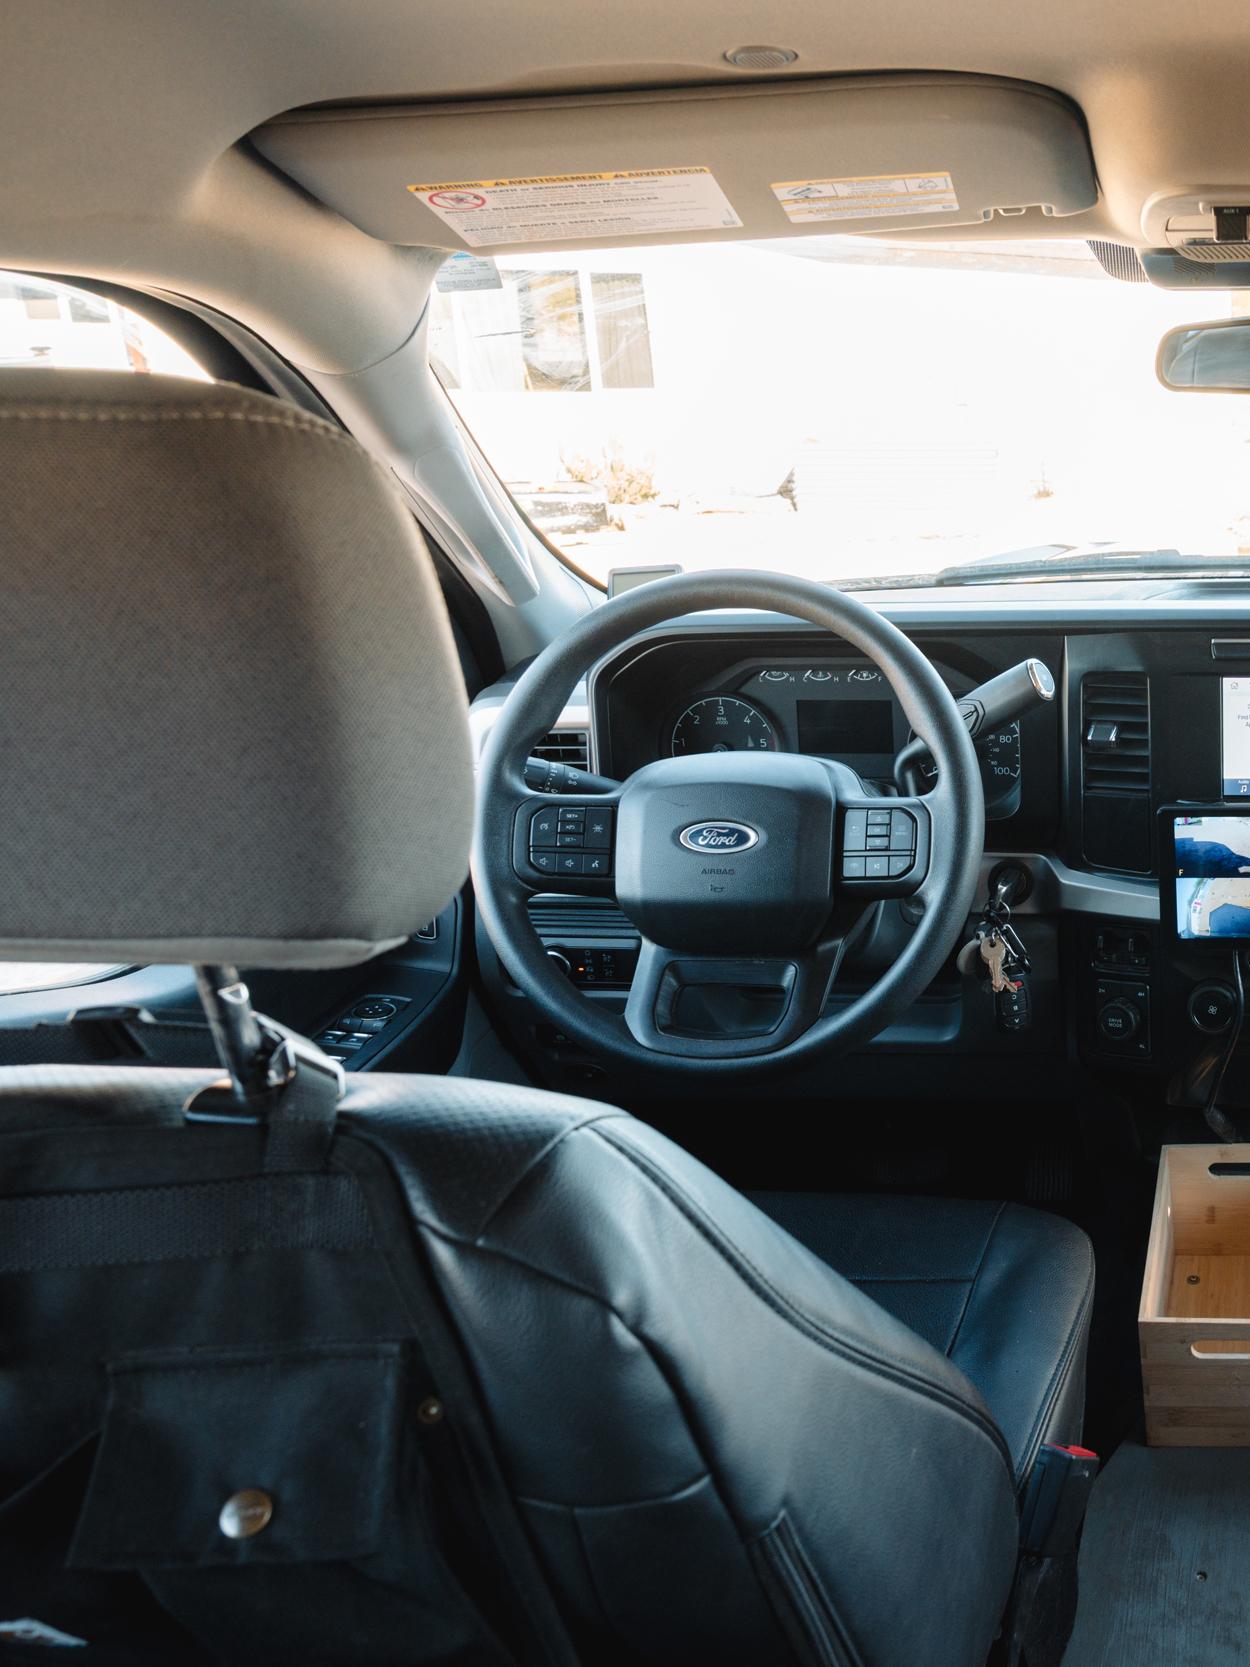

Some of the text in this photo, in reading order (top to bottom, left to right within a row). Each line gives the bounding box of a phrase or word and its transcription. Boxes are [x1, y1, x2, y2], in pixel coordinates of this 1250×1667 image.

[427, 167, 707, 191] WARNING AVERTISSEMENT ADVERTENCIA
[718, 706, 724, 715] 3
[694, 716, 700, 724] 2
[744, 716, 751, 724] 4
[999, 735, 1012, 743] 80
[760, 739, 767, 748] 5
[993, 767, 1010, 775] 100
[698, 828, 739, 846] Ford
